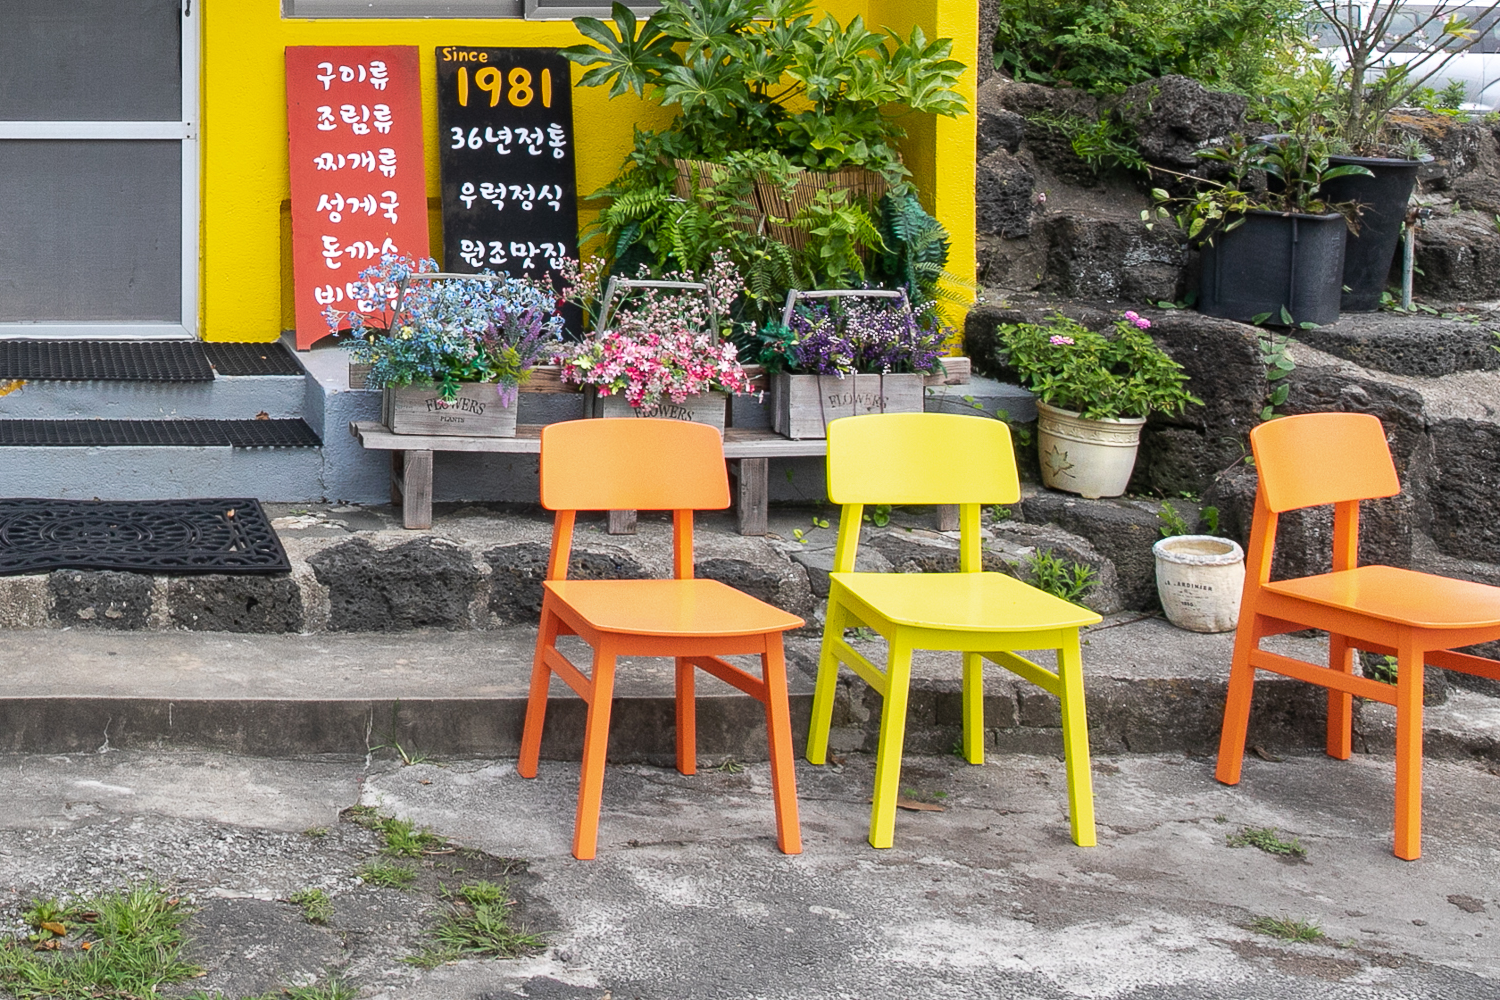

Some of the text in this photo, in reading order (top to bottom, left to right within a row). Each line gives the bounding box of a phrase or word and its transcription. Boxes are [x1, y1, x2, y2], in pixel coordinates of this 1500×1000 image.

[442, 47, 489, 63] Since
[316, 60, 389, 91] 구이류
[457, 66, 552, 108] 1981
[316, 104, 394, 135] 조림류
[450, 122, 567, 159] 36년전통
[313, 148, 398, 179] 찌개류
[316, 190, 400, 225] 성게국
[459, 182, 563, 212] 우럭정식
[459, 239, 567, 270] 원조맛집
[440, 415, 465, 423] PLANTS
